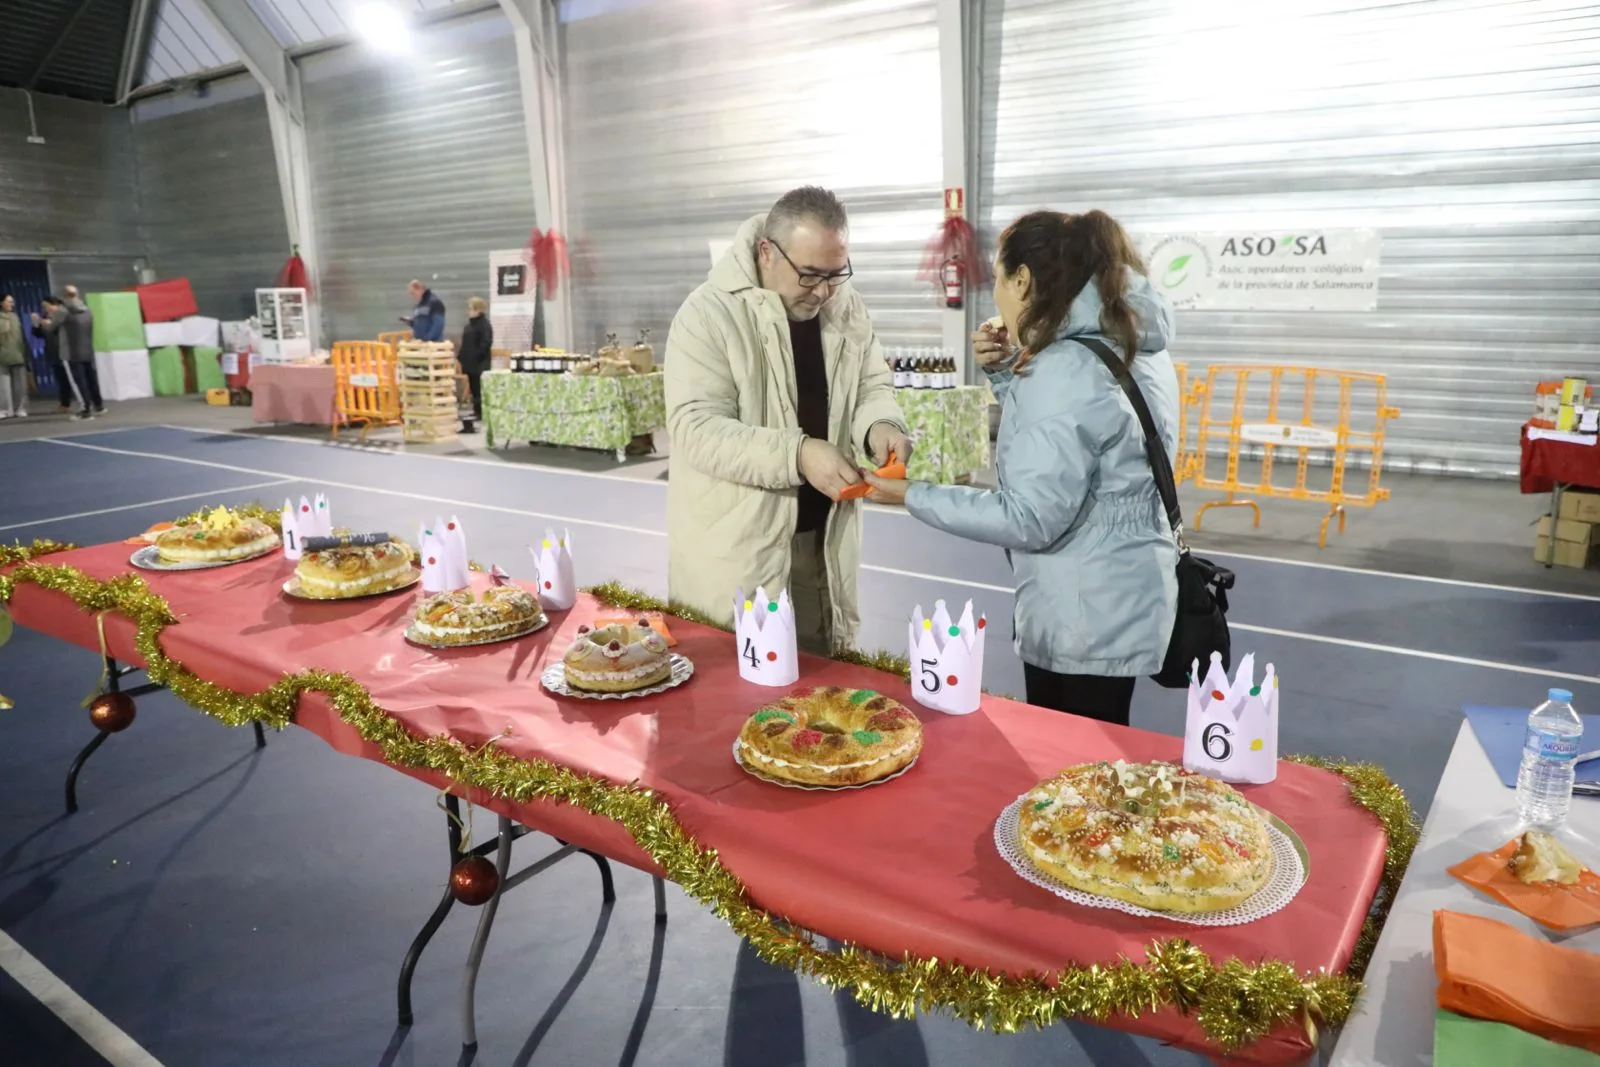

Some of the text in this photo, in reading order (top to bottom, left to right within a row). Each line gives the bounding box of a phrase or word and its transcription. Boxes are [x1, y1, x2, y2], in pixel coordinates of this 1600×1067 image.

[1248, 264, 1306, 276] operadores
[1217, 279, 1374, 292] de la provincia de Salamanca
[286, 529, 297, 551] 1
[742, 637, 761, 671] 4
[920, 658, 943, 694] 5
[1202, 722, 1234, 762] 6
